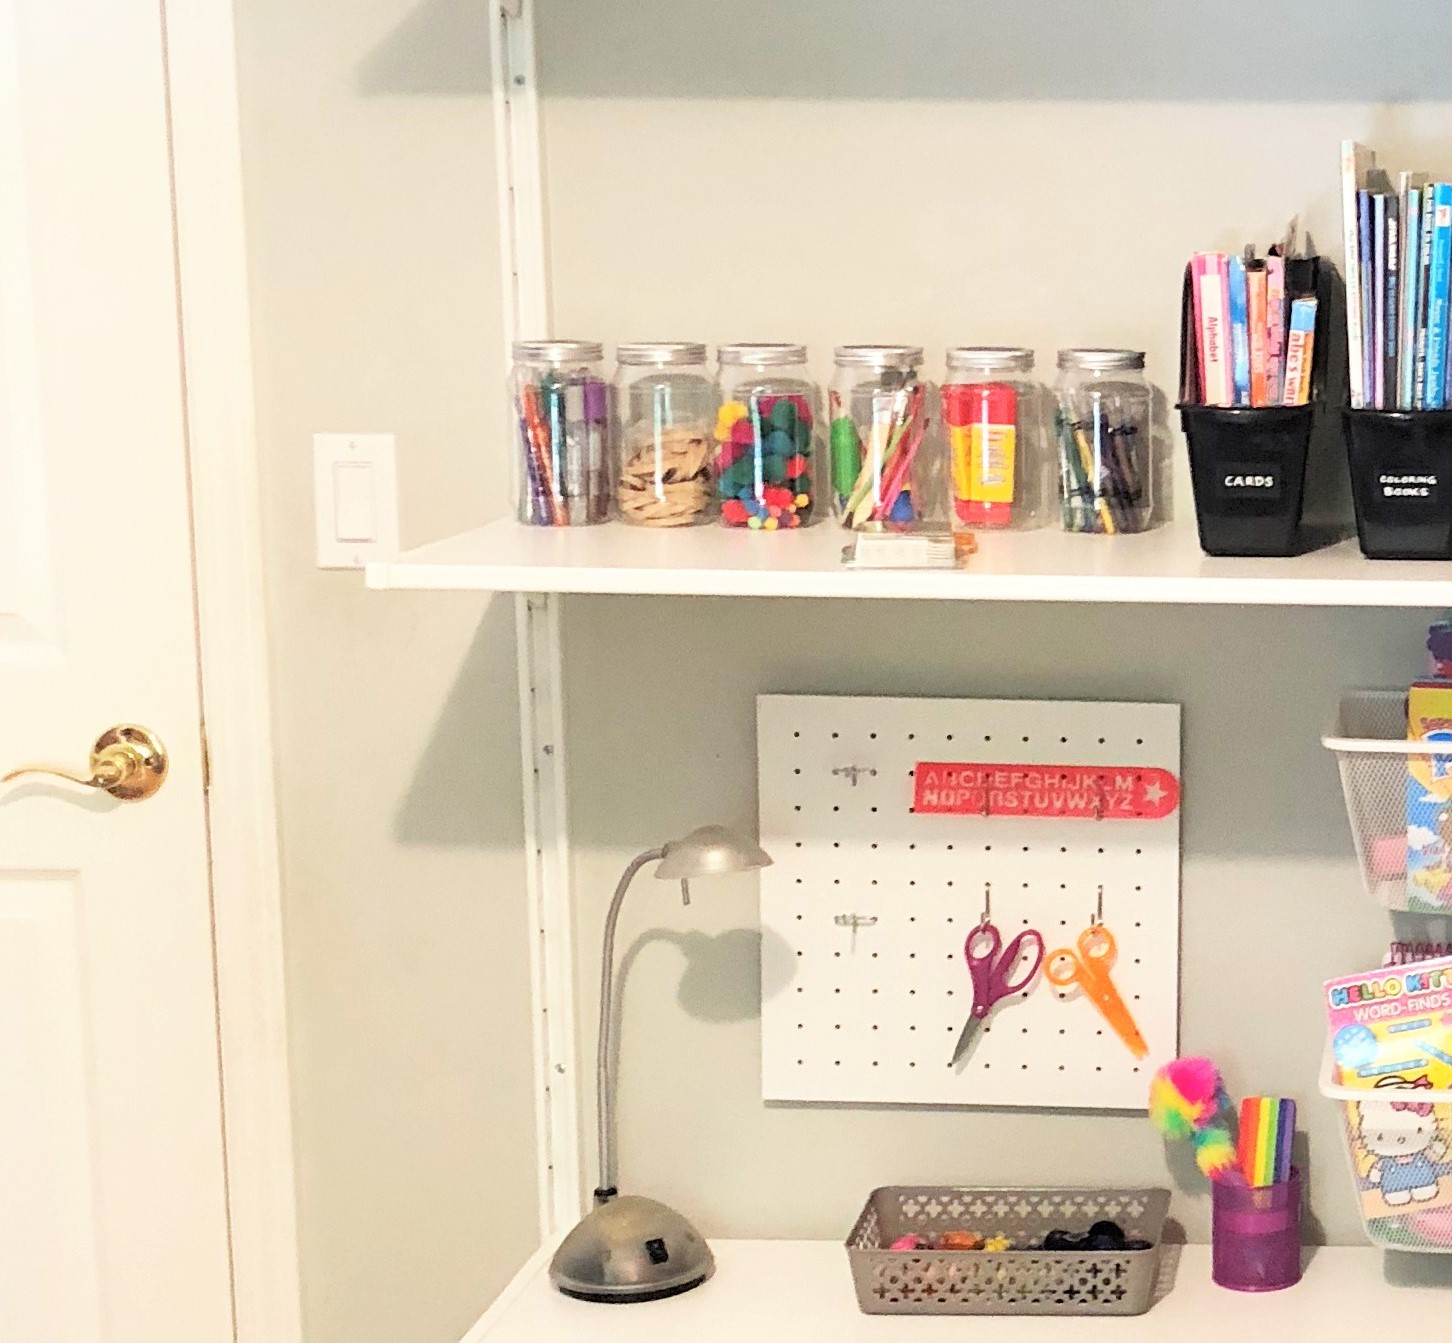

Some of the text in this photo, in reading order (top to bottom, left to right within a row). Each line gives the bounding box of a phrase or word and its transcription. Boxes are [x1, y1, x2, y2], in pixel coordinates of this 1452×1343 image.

[1205, 316, 1219, 363] Alphabet
[1224, 475, 1274, 488] CARDS
[1379, 474, 1438, 485] COLORING
[1383, 486, 1430, 497] BOOKS
[1330, 977, 1402, 1007] HELLO
[1353, 992, 1452, 1022] WORD-FINDS
